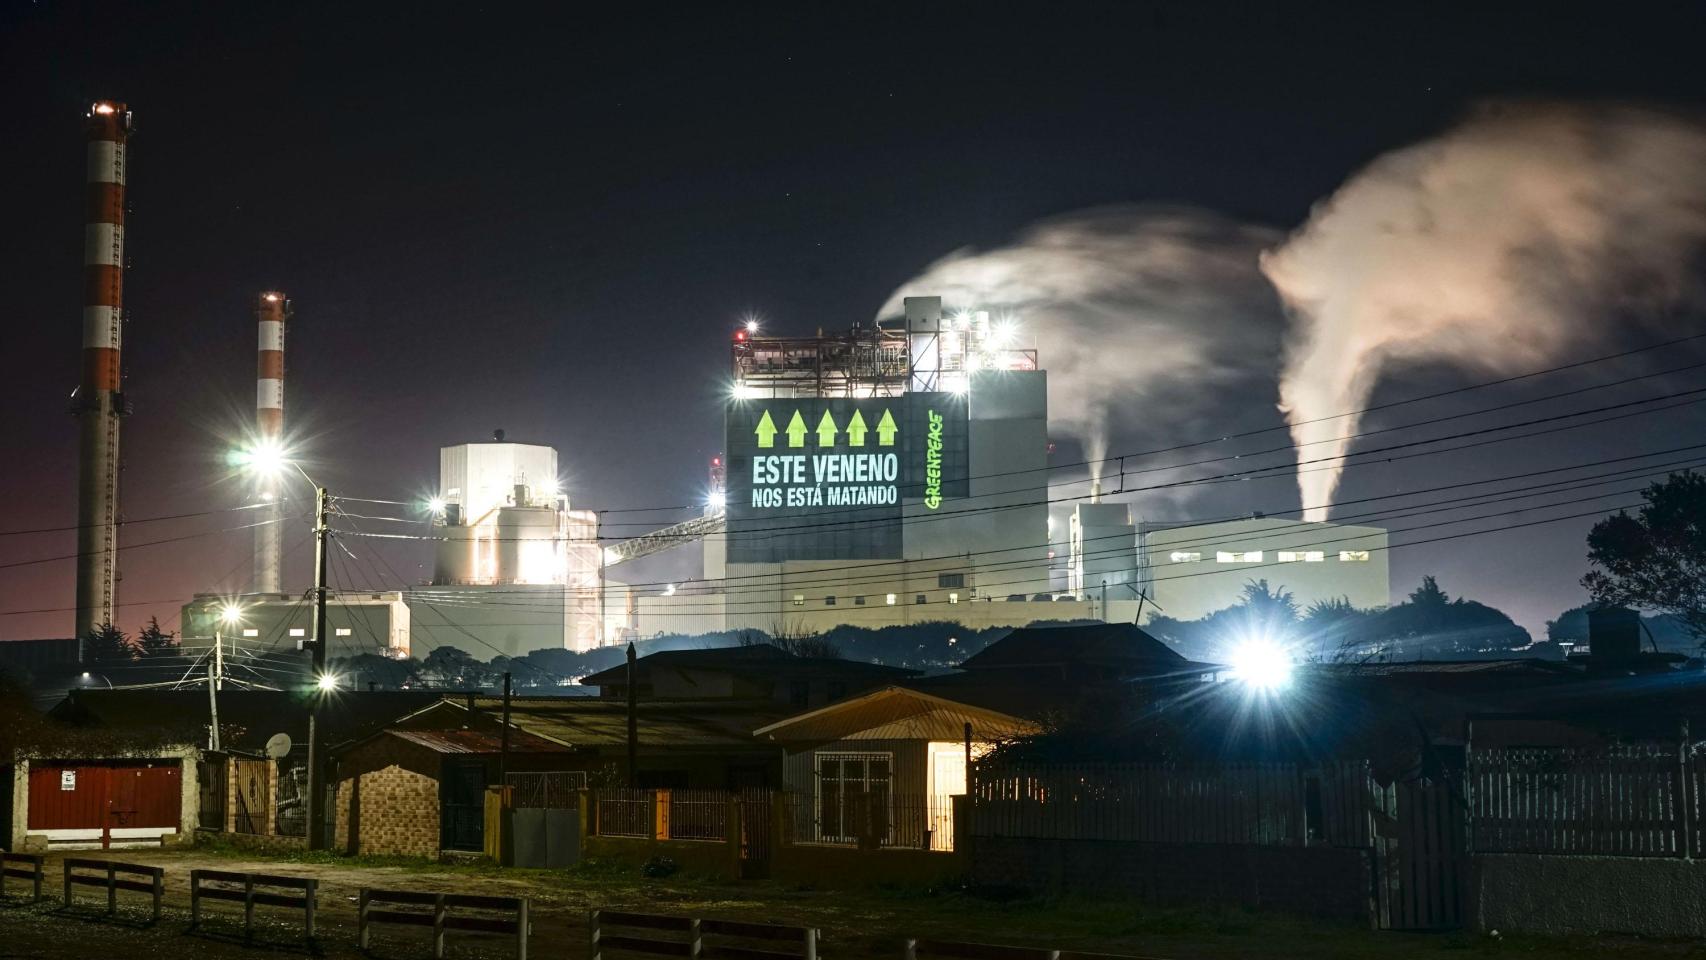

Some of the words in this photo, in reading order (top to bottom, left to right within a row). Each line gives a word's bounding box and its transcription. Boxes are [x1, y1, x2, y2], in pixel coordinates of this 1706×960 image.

[753, 455, 806, 483] ESTE
[813, 453, 897, 482] VENENO
[925, 410, 943, 509] GREENPEACE
[752, 488, 782, 508] NOS
[787, 483, 823, 506] ESTÁ
[827, 485, 897, 505] MATANDO
